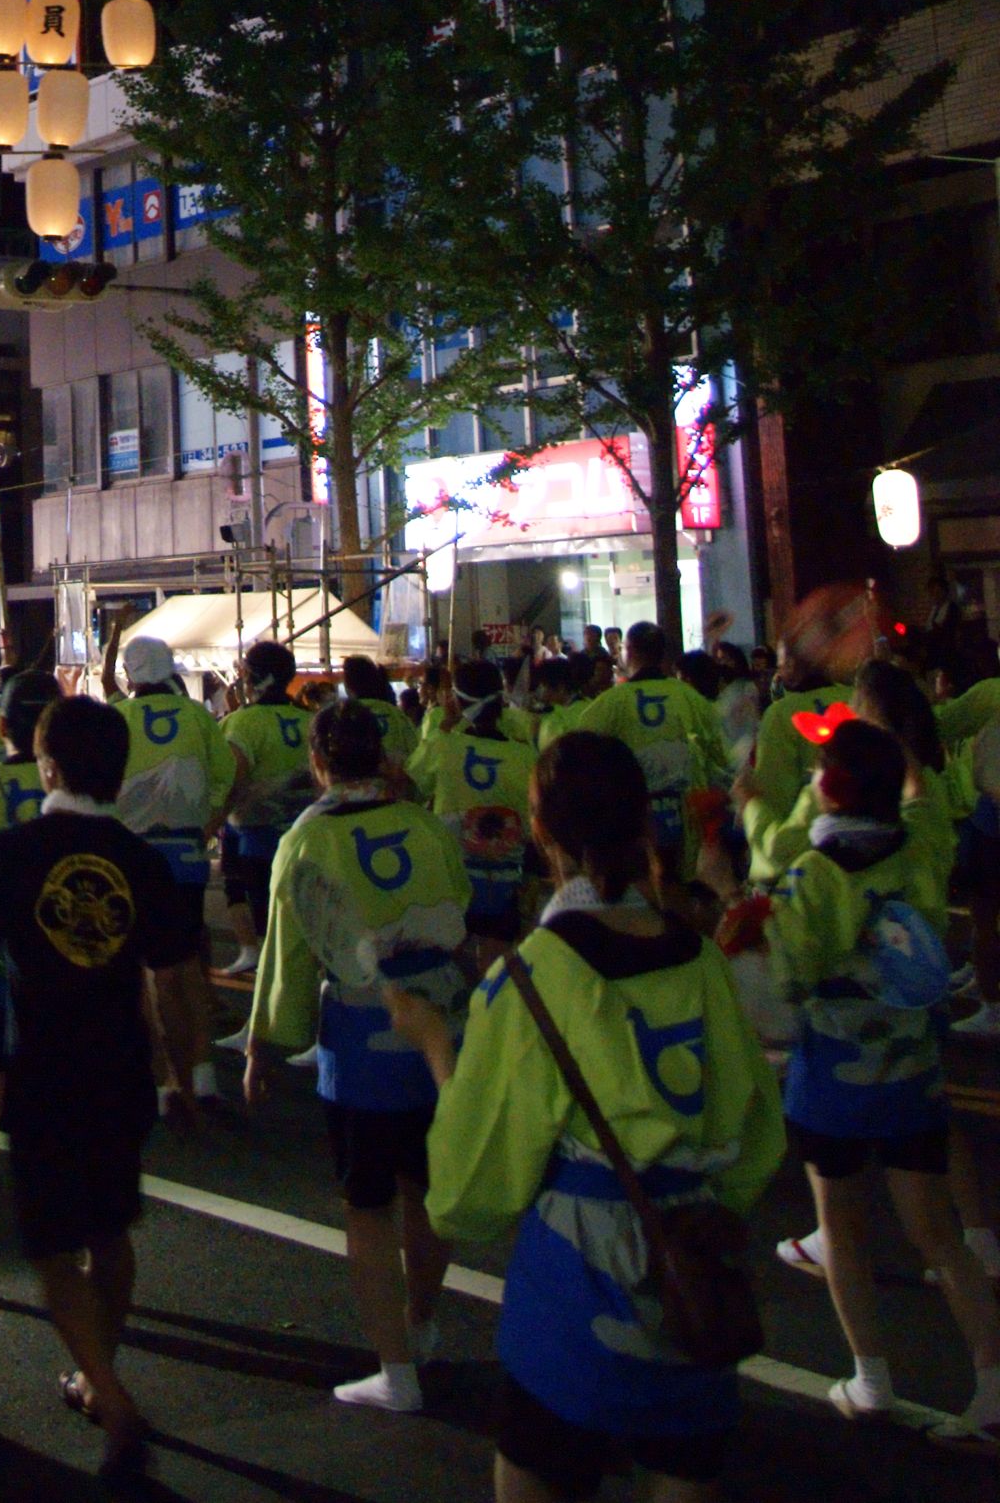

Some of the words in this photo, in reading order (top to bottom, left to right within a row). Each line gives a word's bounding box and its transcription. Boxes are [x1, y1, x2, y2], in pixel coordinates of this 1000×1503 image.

[508, 458, 627, 521] アコム
[691, 506, 711, 524] 1F
